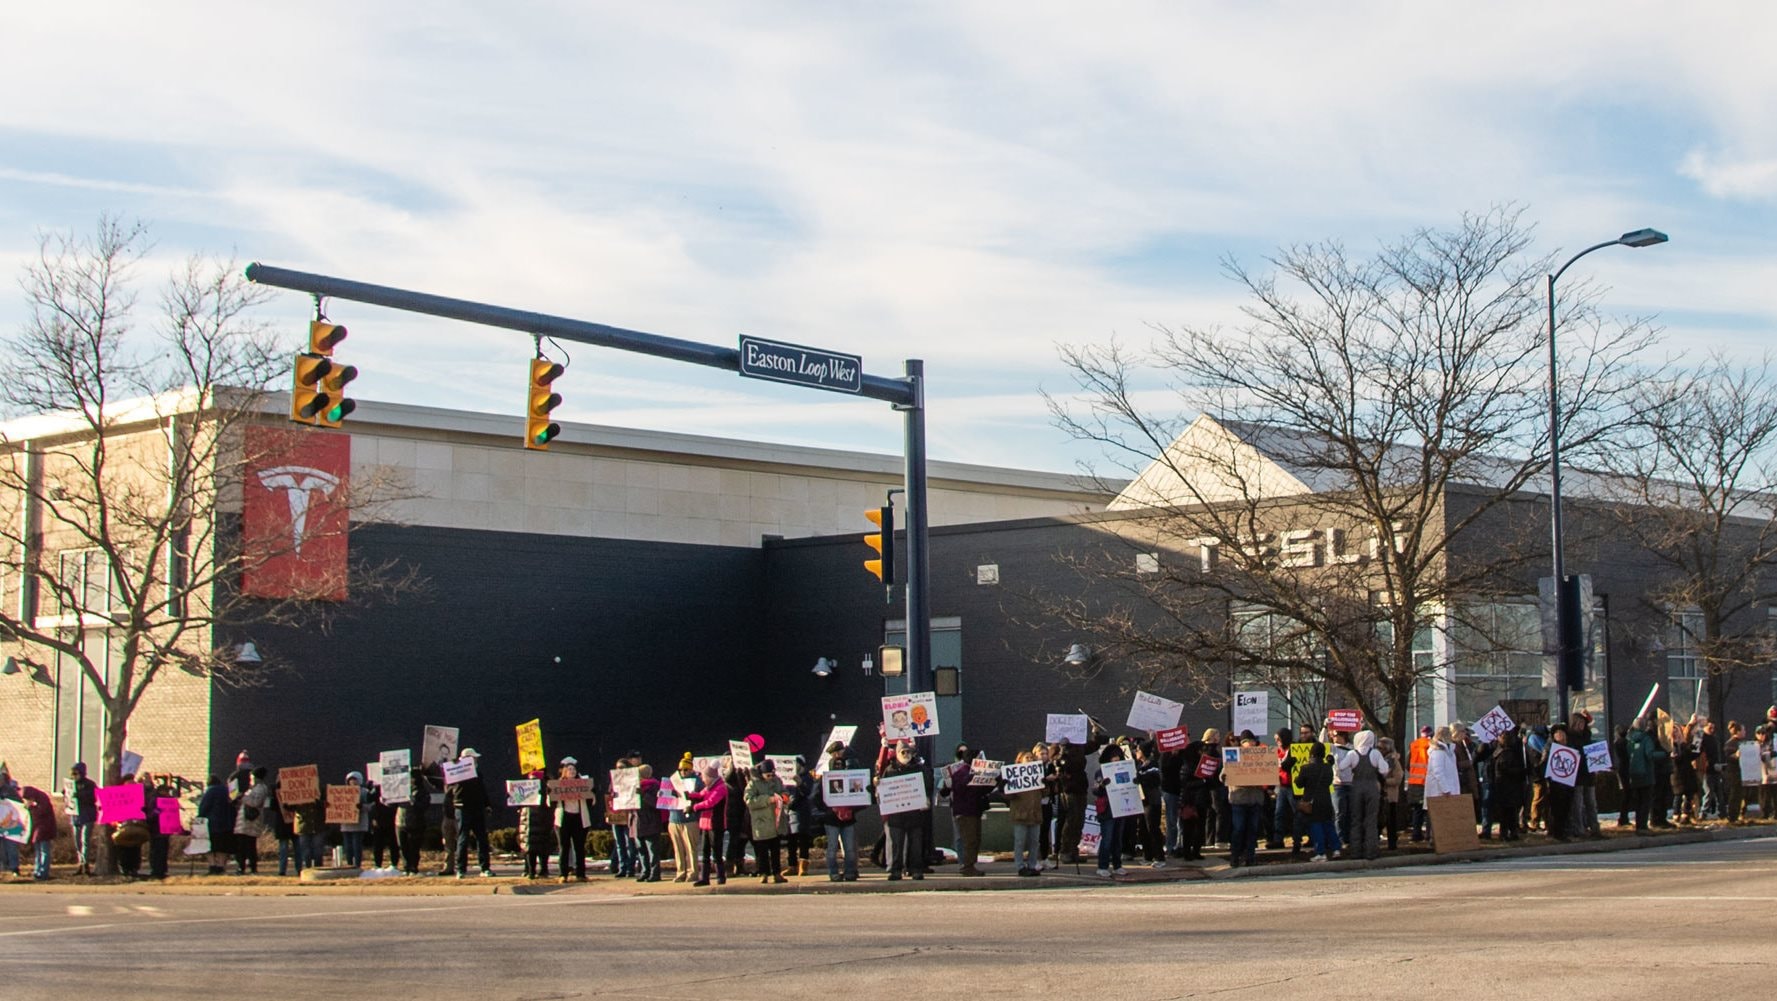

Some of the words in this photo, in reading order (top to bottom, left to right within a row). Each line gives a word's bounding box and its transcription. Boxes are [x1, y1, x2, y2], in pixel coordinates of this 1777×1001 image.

[747, 344, 796, 373] Easton
[799, 354, 828, 383] Loop
[829, 358, 856, 382] West
[1006, 763, 1043, 779] DEPORT
[1007, 775, 1040, 790] MUSK
